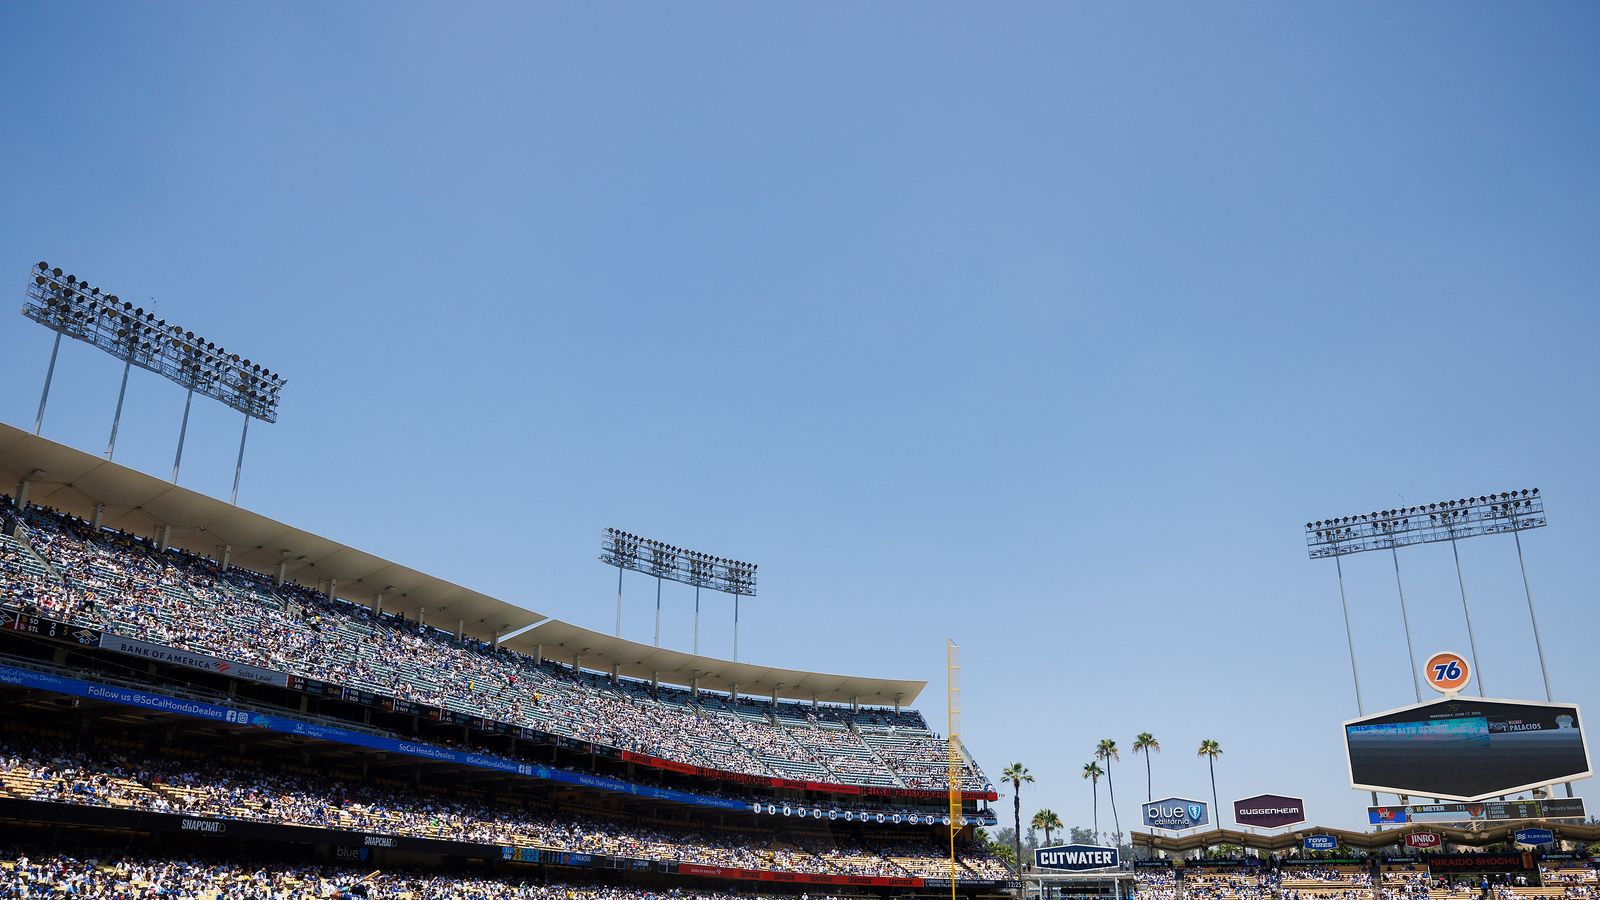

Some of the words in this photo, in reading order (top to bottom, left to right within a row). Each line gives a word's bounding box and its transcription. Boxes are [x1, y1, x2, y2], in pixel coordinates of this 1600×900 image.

[49, 629, 55, 637] 0
[120, 643, 149, 656] BANK
[152, 650, 165, 659] OF
[167, 655, 210, 669] AMERICA
[238, 669, 254, 678] Suite
[256, 673, 272, 682] Level
[1434, 661, 1461, 681] 76
[88, 686, 119, 699] Follow
[121, 693, 131, 701] us
[133, 694, 223, 718] @SoCalHondaDealers
[1509, 723, 1541, 731] PALACIOS
[399, 744, 415, 752] SoCal
[416, 746, 434, 756] Honda
[435, 750, 455, 760] Dealers
[885, 788, 914, 798] ANGELES
[914, 790, 949, 800] DODGERS
[1148, 805, 1184, 818] blue
[1239, 807, 1299, 816] GUGGENHEIM
[182, 819, 220, 832] SNAPCHAT
[1154, 818, 1190, 826] california
[364, 836, 393, 847] SNAPCHAT
[1411, 834, 1435, 843] JINRO
[336, 846, 359, 858] blue
[1040, 851, 1112, 865] CUTWATER
[1431, 858, 1473, 867] NIKAIDO
[1475, 857, 1520, 866] SHOCHU
